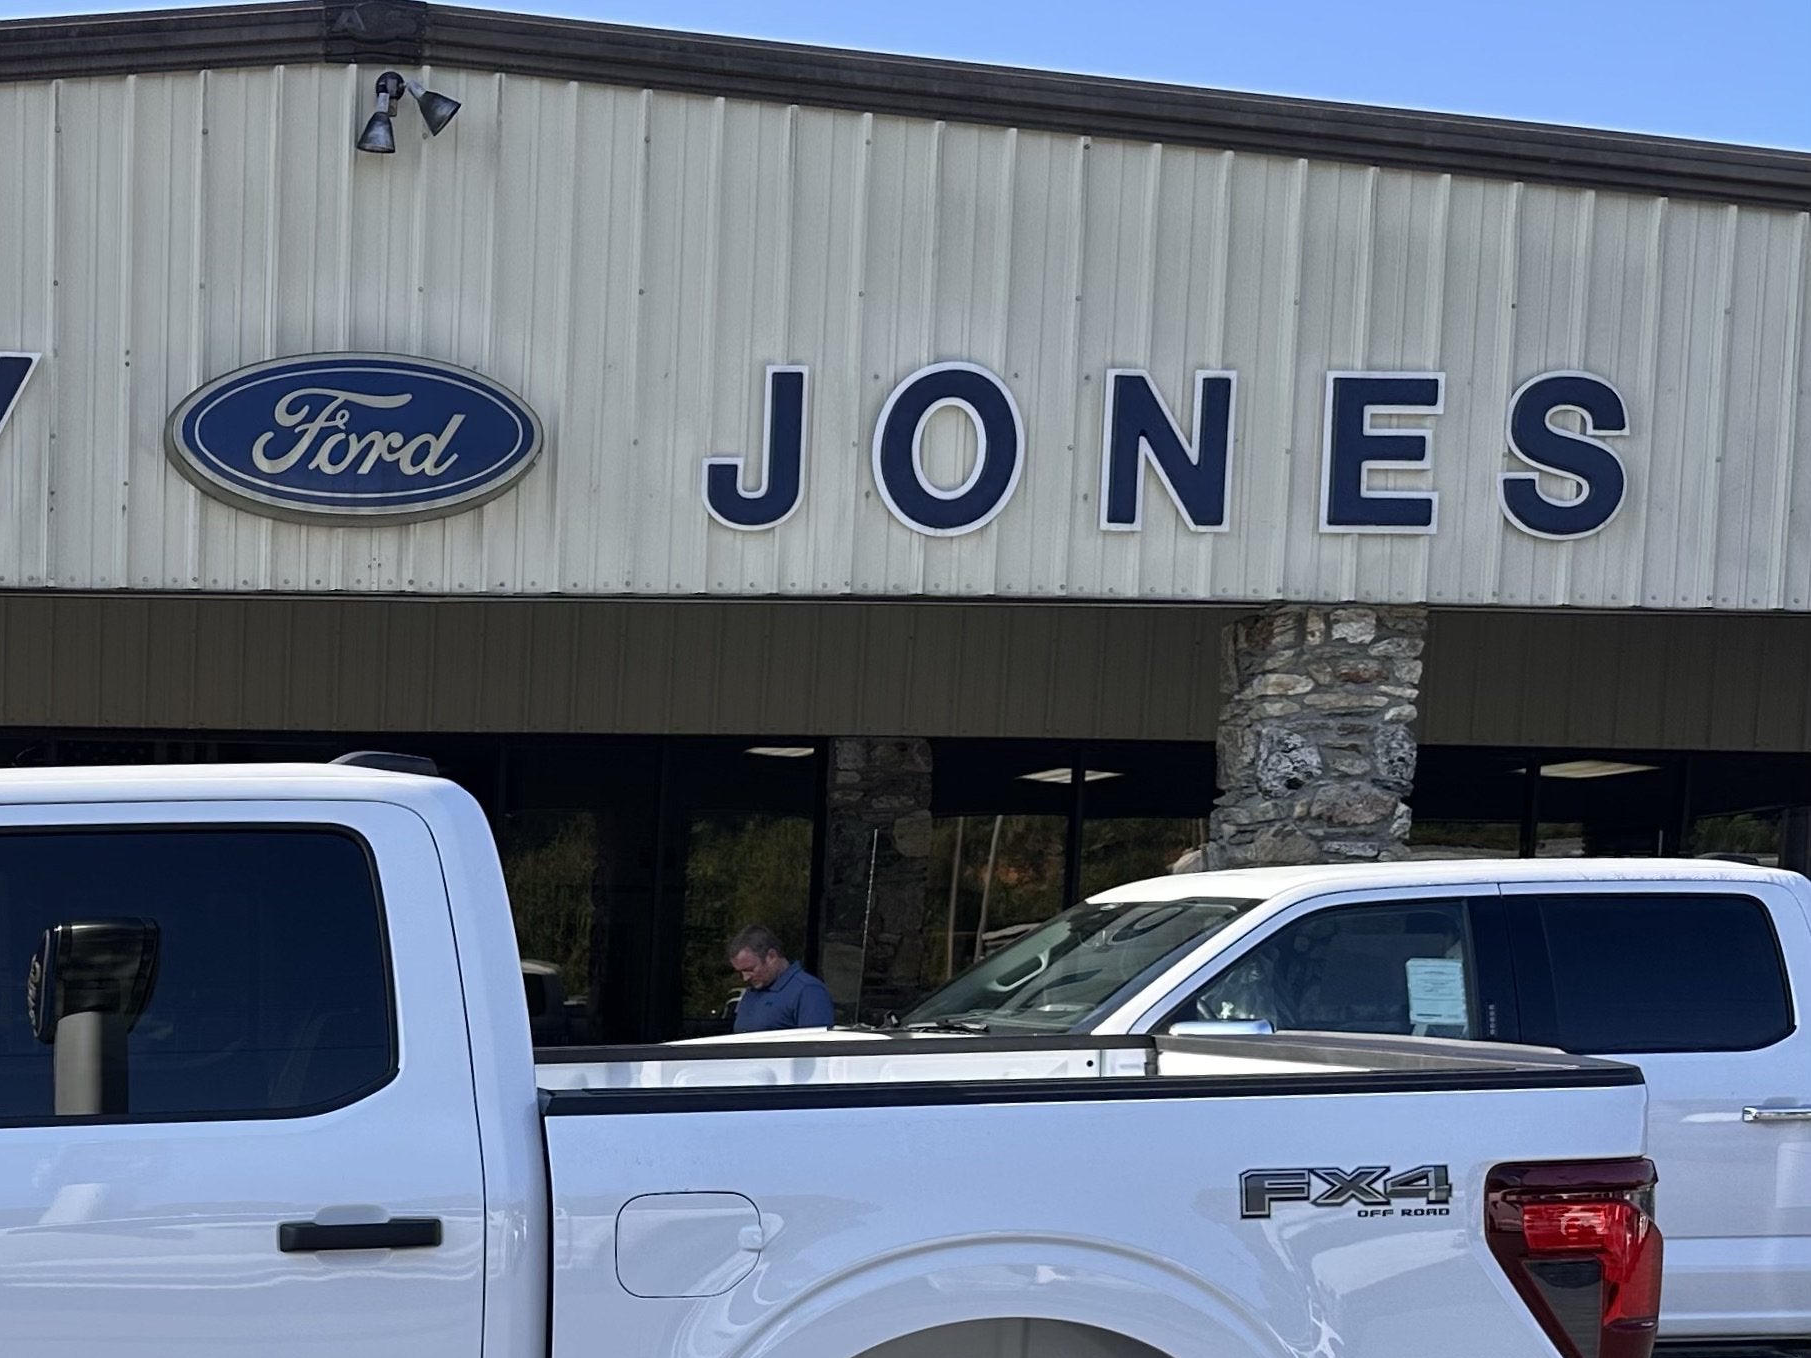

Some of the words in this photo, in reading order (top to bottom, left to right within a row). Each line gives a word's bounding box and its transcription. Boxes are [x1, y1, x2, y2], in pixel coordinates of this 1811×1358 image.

[251, 387, 467, 477] Ford
[702, 361, 1630, 541] JONES
[1238, 1163, 1453, 1219] FX4
[1357, 1209, 1394, 1218] OFF
[1400, 1207, 1450, 1217] ROAD
